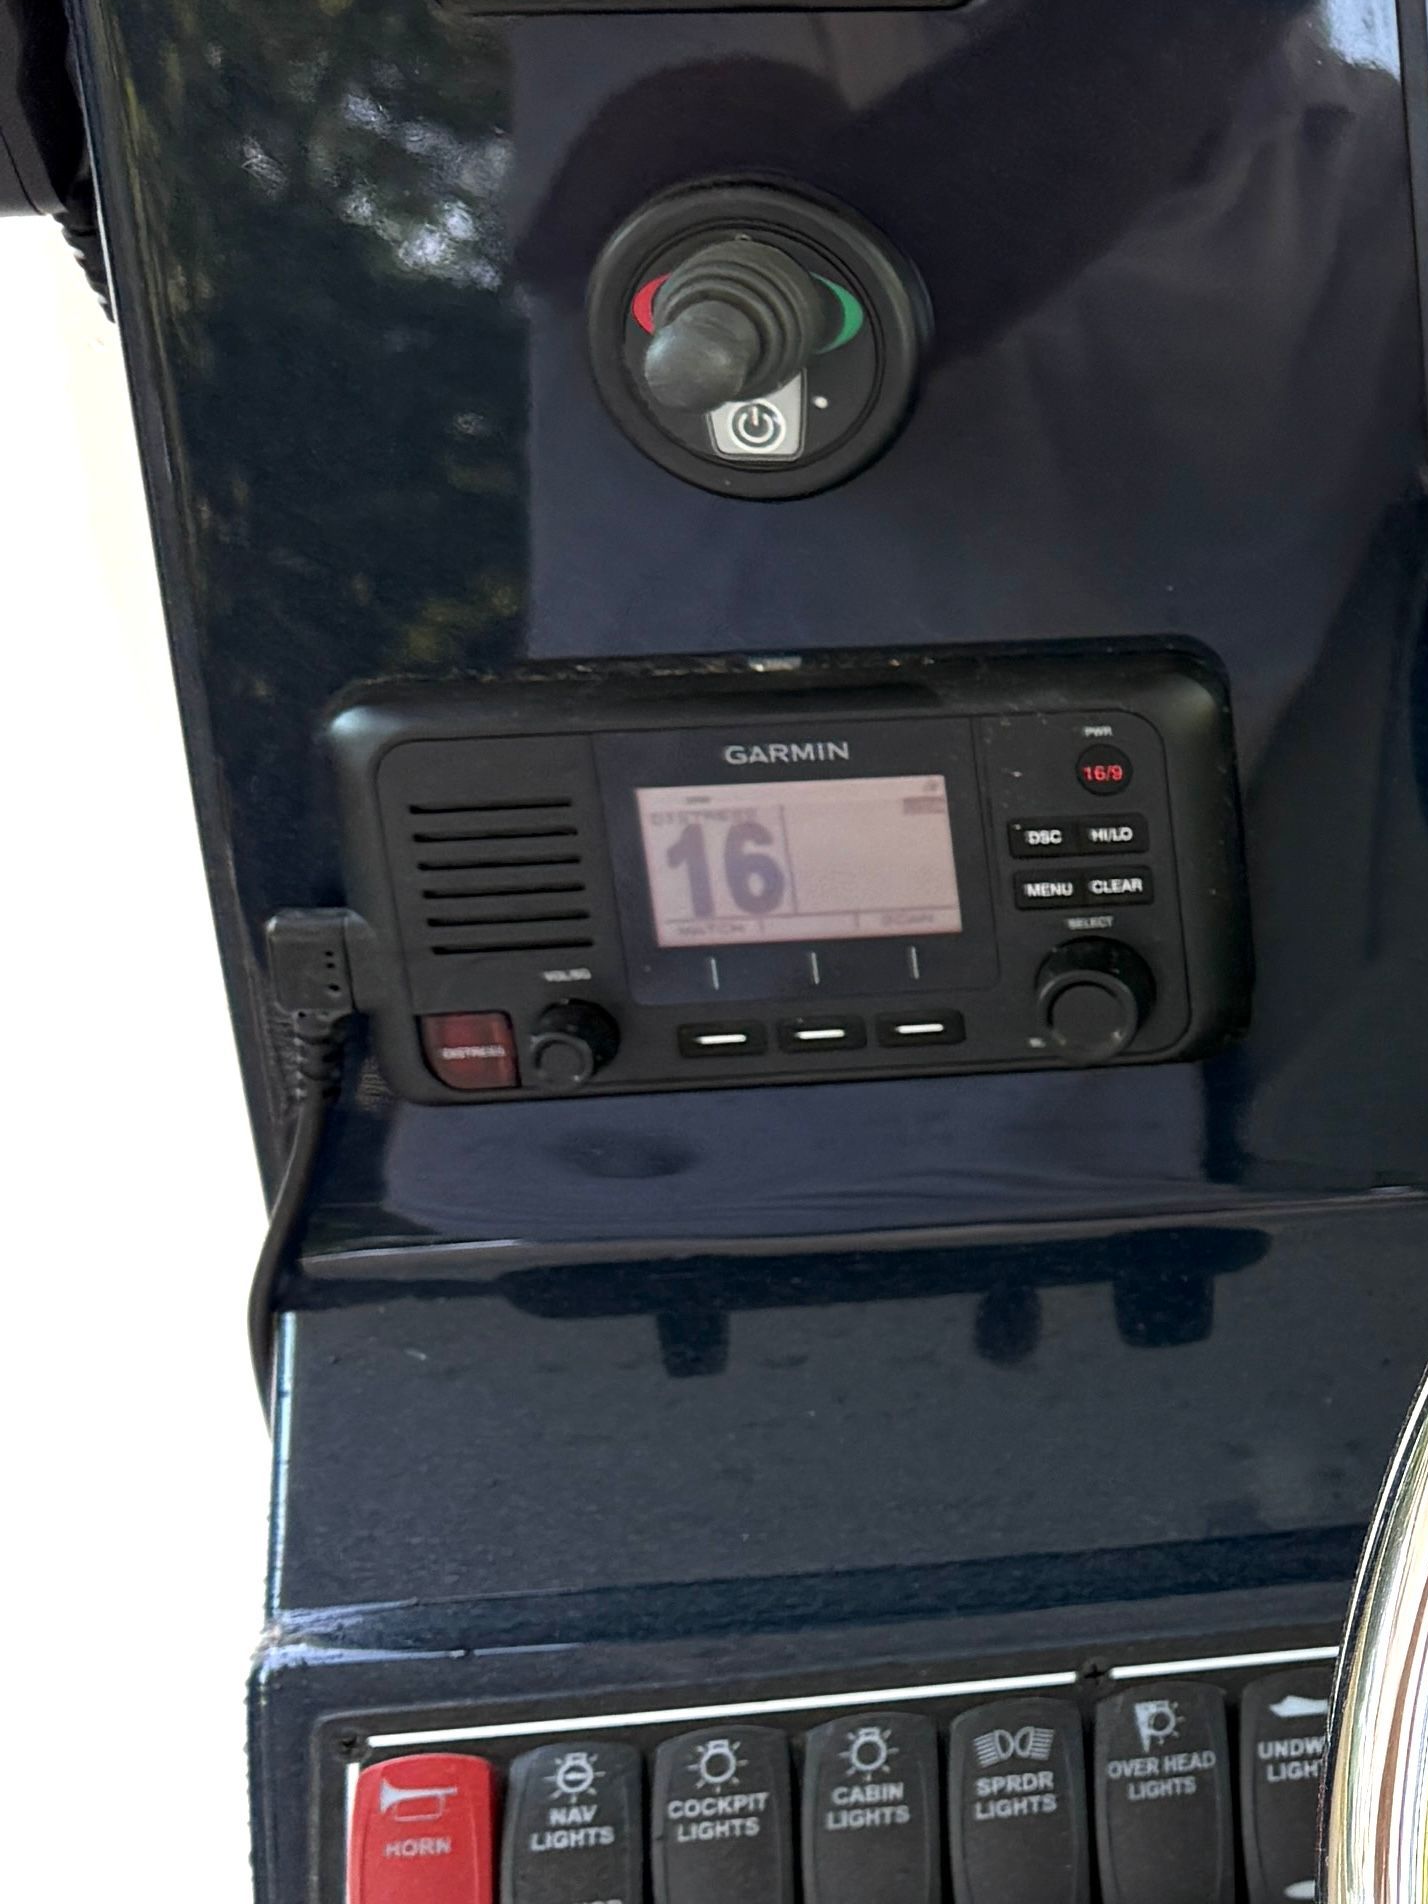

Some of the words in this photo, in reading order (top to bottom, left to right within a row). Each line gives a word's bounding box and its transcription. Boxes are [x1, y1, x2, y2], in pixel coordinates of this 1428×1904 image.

[1083, 725, 1114, 738] PWR
[723, 741, 851, 768] GARMIN
[1082, 764, 1125, 782] 16/9
[1025, 829, 1063, 846] DSC
[1088, 826, 1134, 843] HI/LO
[665, 821, 786, 920] 16
[1025, 881, 1074, 898] MENU
[1088, 877, 1144, 895] CLEAR
[1066, 914, 1115, 930] SELECT
[1106, 1755, 1161, 1781] OVER
[1163, 1749, 1218, 1775] HEAD
[1266, 1758, 1321, 1783] LIGH
[830, 1781, 905, 1807] CABIN
[973, 1770, 1055, 1797] SPRDR
[1127, 1775, 1198, 1801] LIGHTS
[548, 1804, 599, 1825] NAV
[666, 1791, 770, 1819] COCKPIT
[973, 1794, 1060, 1821] LIGHTS
[676, 1817, 762, 1844] LIGHTS
[825, 1805, 911, 1832] LIGHTS
[384, 1837, 453, 1858] HORN
[529, 1827, 616, 1853] LIGHTS
